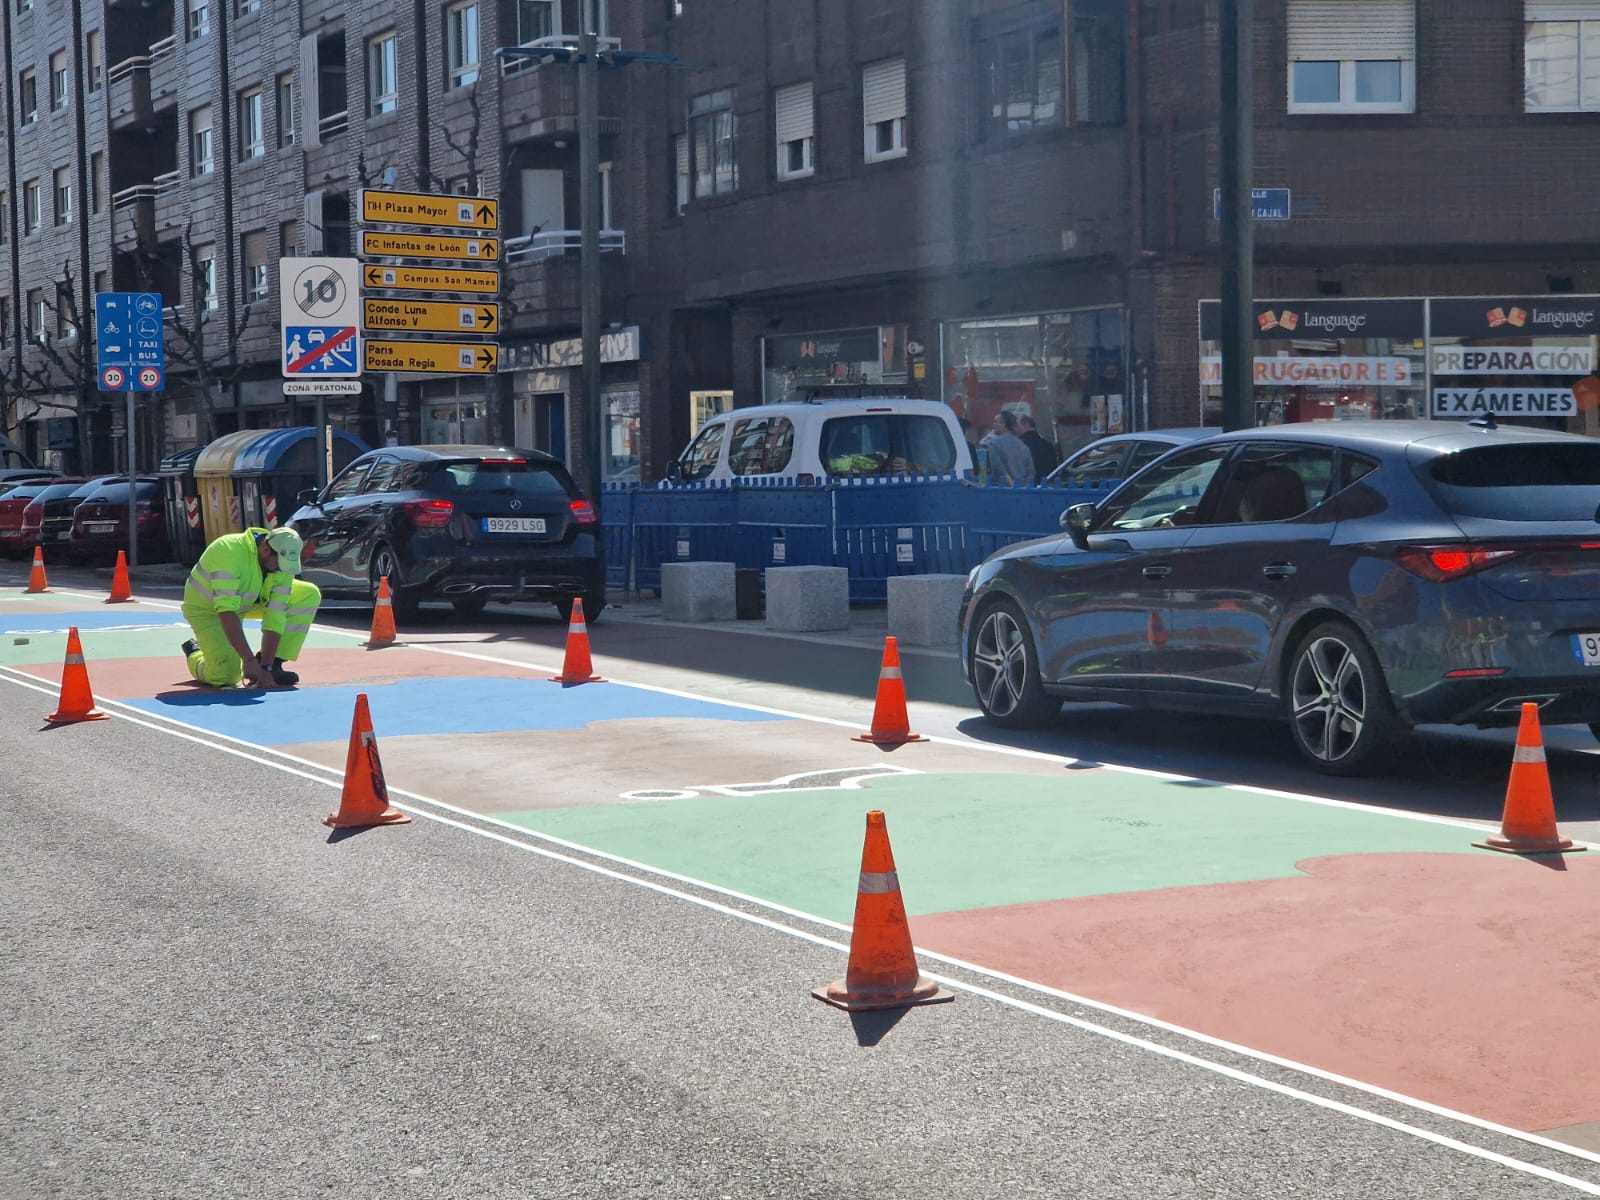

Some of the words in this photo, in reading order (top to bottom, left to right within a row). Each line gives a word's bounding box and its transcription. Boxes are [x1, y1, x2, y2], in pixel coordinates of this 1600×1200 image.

[385, 202, 414, 214] Plaza
[417, 205, 448, 217] Mayor
[1257, 208, 1283, 218] CAJAL
[366, 239, 379, 249] FC
[383, 240, 421, 251] Infantas
[425, 243, 436, 251] de
[403, 274, 440, 284] Campus
[444, 275, 461, 284] San
[303, 279, 337, 303] 10
[367, 303, 400, 314] Conde
[404, 304, 428, 315] Luna
[367, 315, 407, 326] Alfonso
[412, 317, 419, 326] V
[1303, 311, 1369, 332] Language
[1532, 308, 1594, 328] Language
[368, 344, 394, 355] Paris
[368, 356, 404, 367] Posada
[409, 357, 436, 369] Regia
[1433, 347, 1590, 371] PREPARACIÓN
[1201, 361, 1408, 382] MRUGADORES
[107, 374, 120, 382] 30
[143, 374, 156, 382] 20
[287, 384, 311, 393] ZONA
[314, 383, 358, 392] PEATONAL
[1436, 388, 1573, 412] EXÁMENES
[489, 519, 519, 531] 9929
[521, 520, 544, 531] LSG
